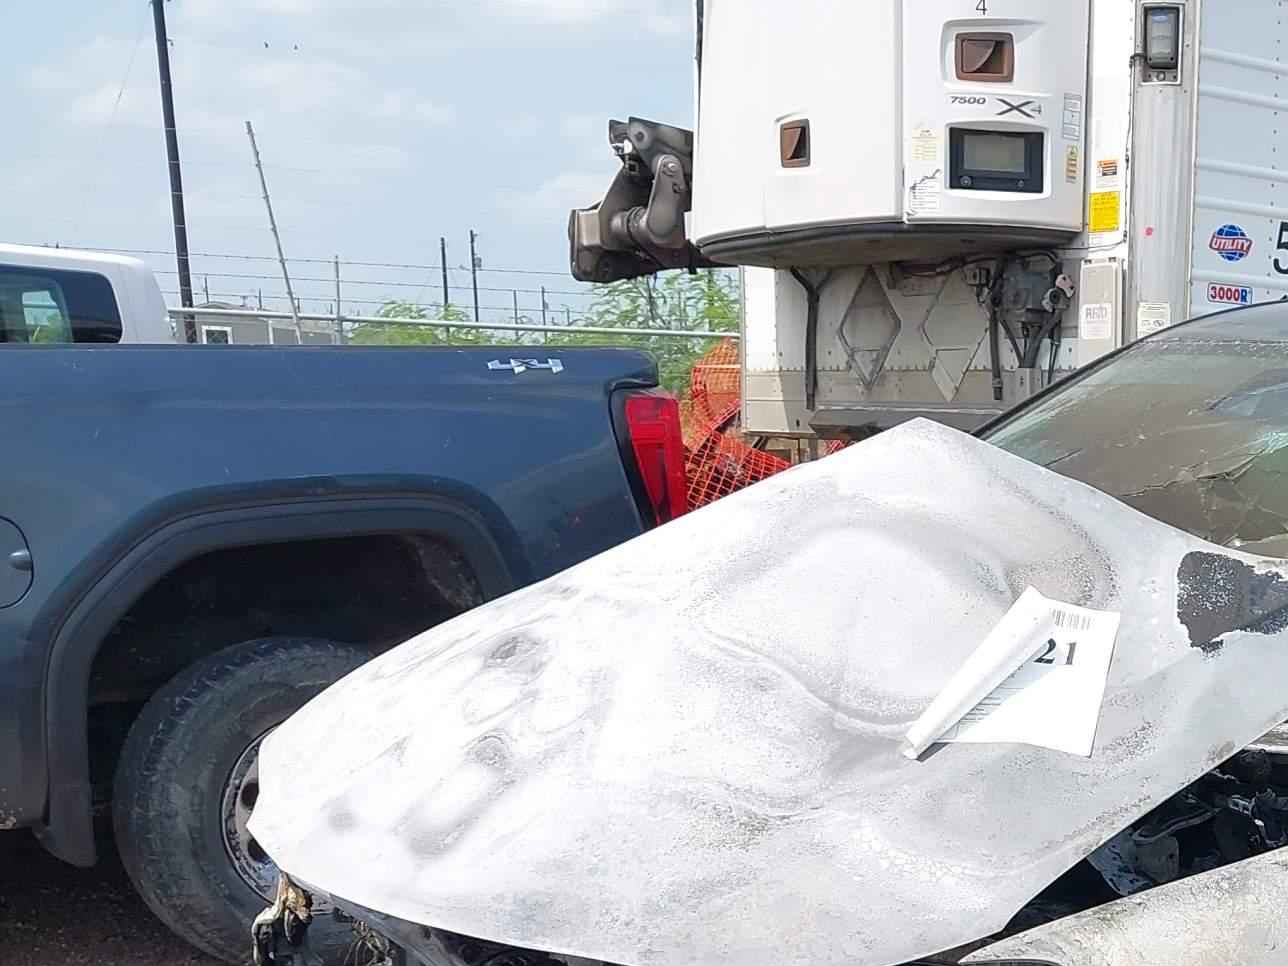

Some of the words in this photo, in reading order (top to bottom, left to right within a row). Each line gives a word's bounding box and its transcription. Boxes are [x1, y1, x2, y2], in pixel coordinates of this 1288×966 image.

[950, 96, 986, 105] 7500
[1211, 237, 1251, 251] UTILITY
[1210, 286, 1248, 302] 3000R
[1085, 306, 1108, 320] RFID
